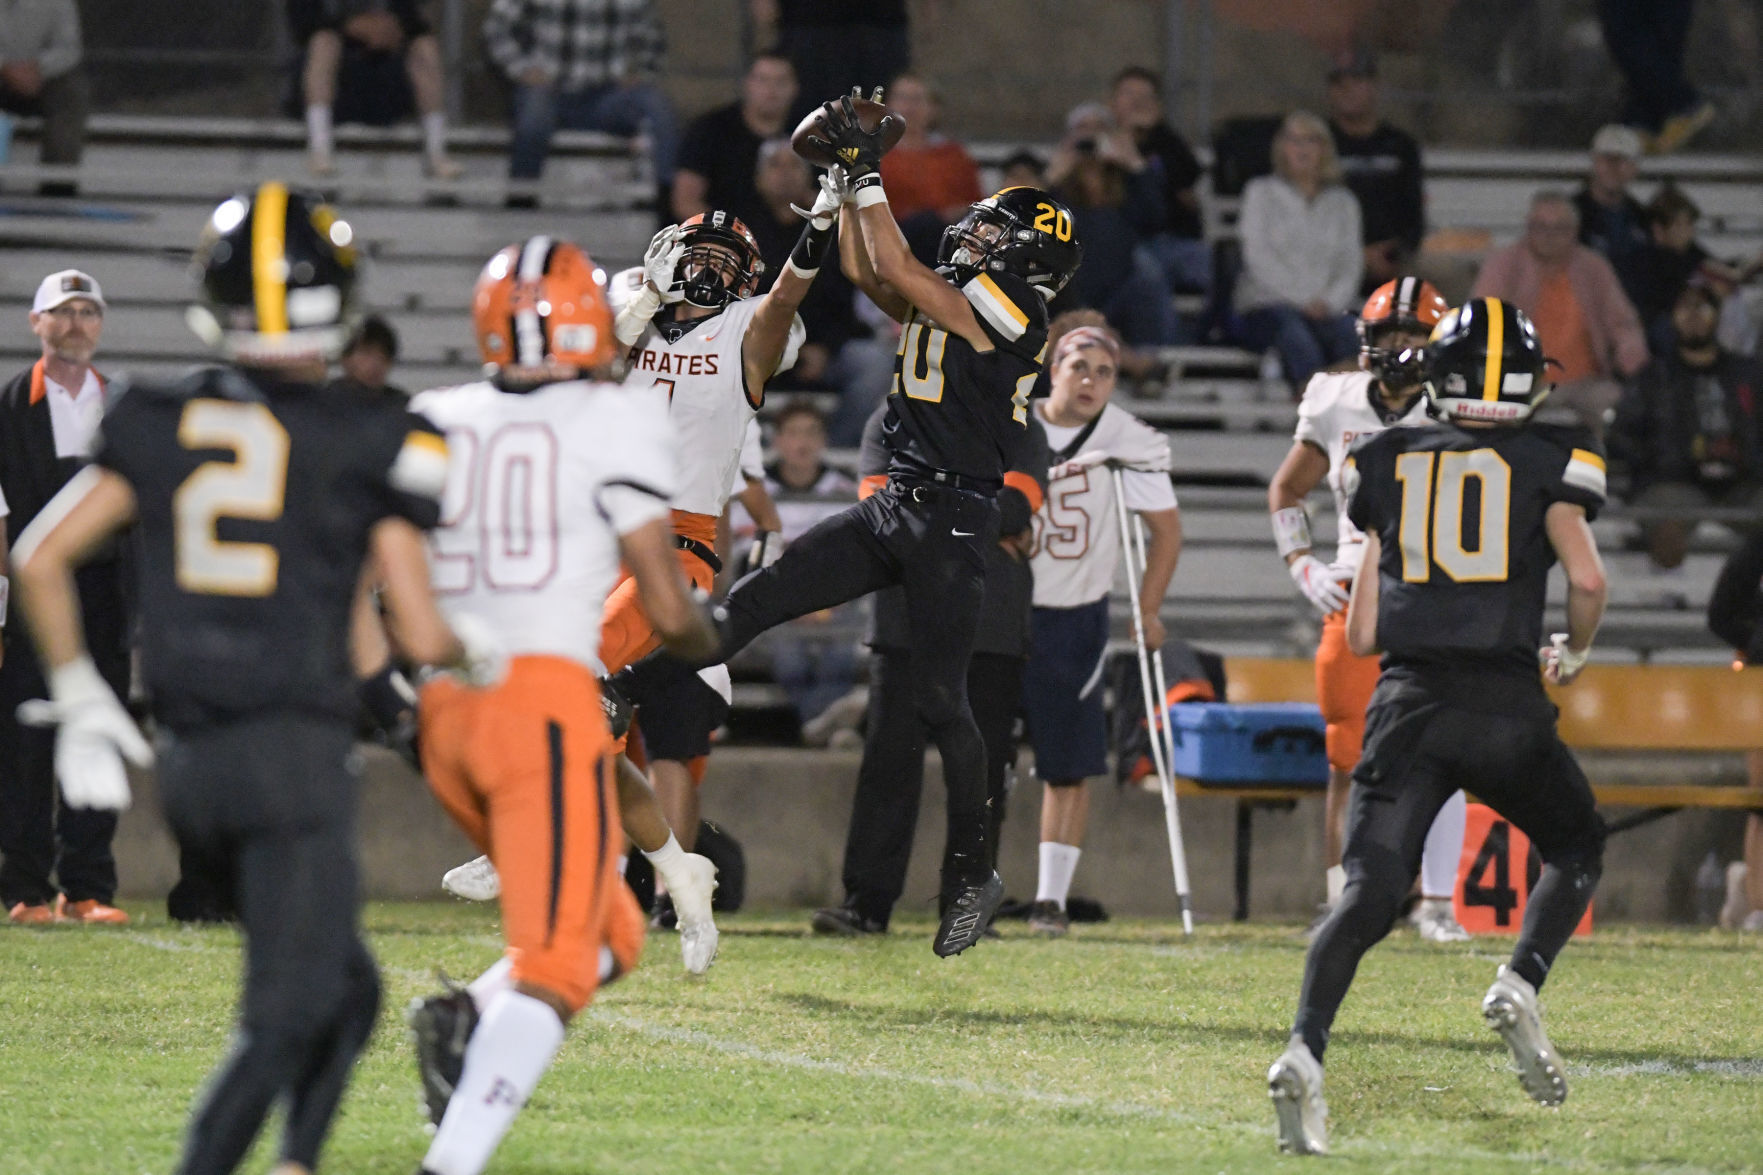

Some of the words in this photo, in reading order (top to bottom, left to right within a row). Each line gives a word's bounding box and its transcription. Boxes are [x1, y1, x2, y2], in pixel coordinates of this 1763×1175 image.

[1034, 202, 1072, 242] 20
[172, 397, 292, 597] 2
[1395, 447, 1512, 583] 10
